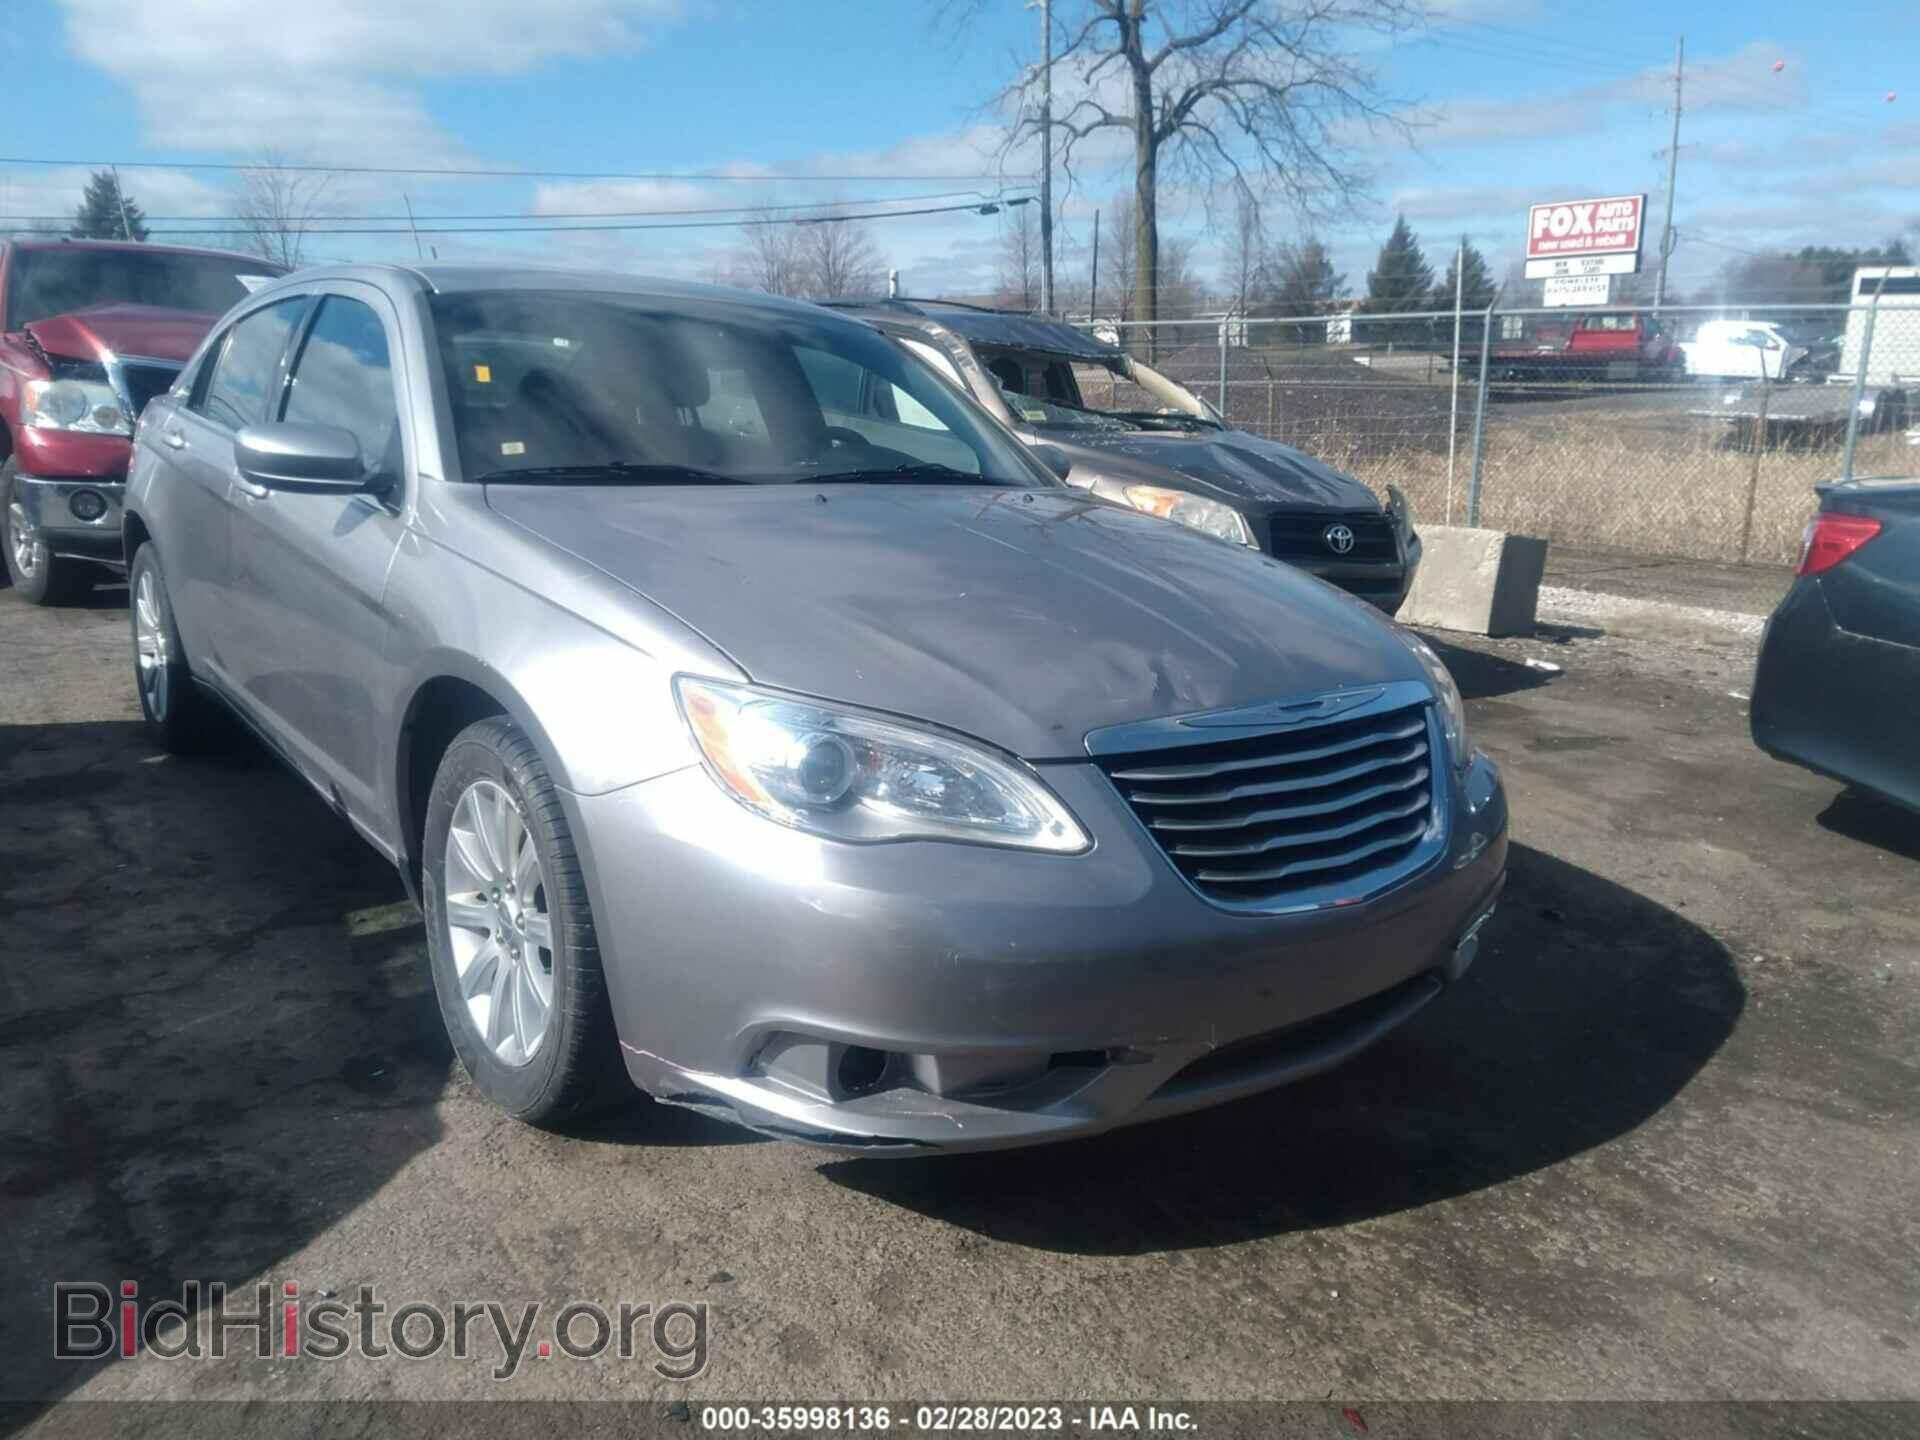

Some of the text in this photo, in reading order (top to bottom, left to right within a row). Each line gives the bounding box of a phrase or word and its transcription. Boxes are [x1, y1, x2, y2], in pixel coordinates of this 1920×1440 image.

[1599, 201, 1633, 216] AUTO
[1532, 205, 1595, 239] FOX
[1596, 216, 1635, 232] PARTS
